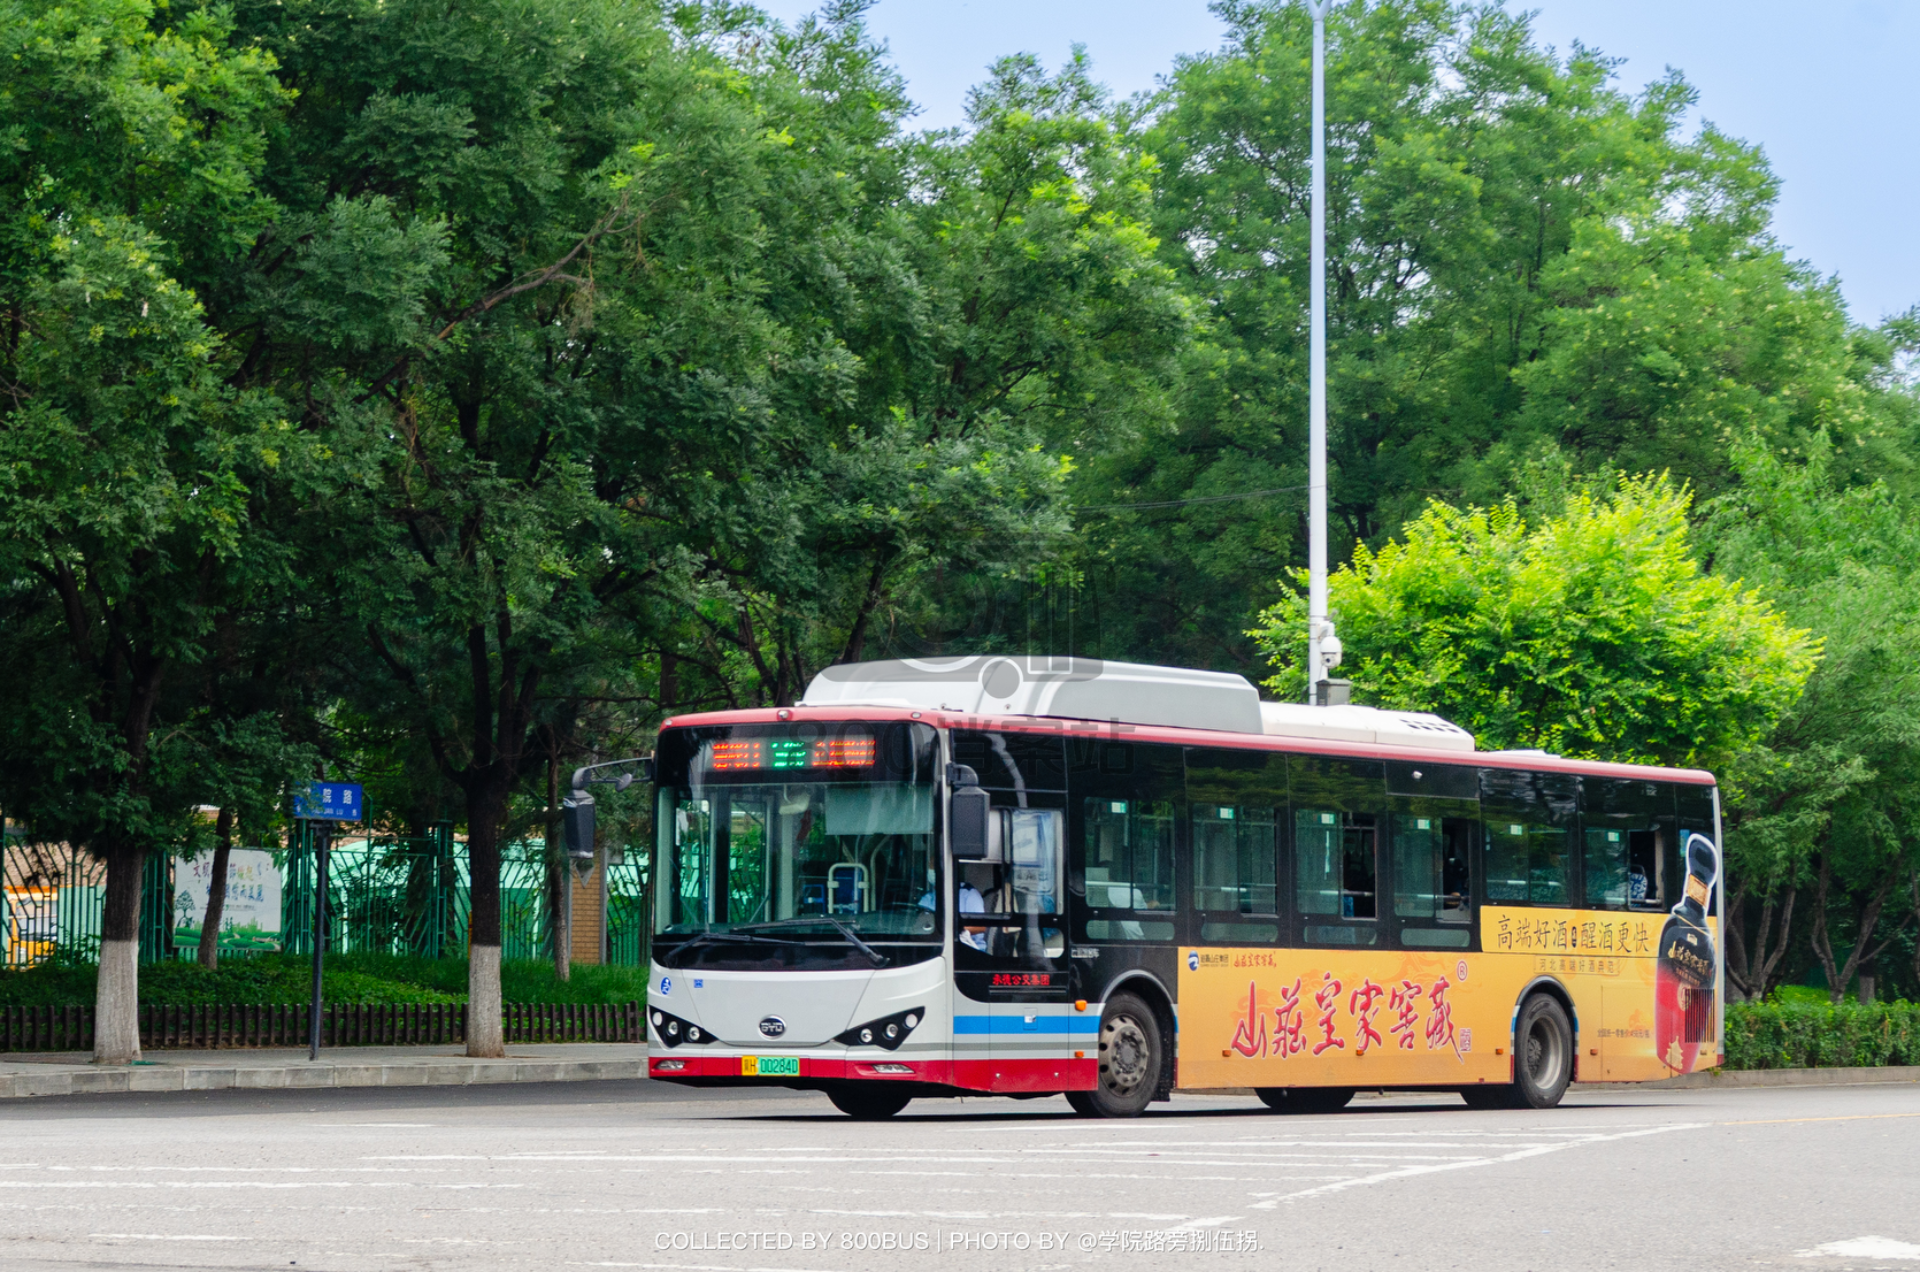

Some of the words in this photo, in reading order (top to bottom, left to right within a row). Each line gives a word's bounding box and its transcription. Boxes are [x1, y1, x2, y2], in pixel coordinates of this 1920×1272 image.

[1498, 914, 1567, 950] 高端好酒
[1581, 922, 1649, 953] 醒酒更快
